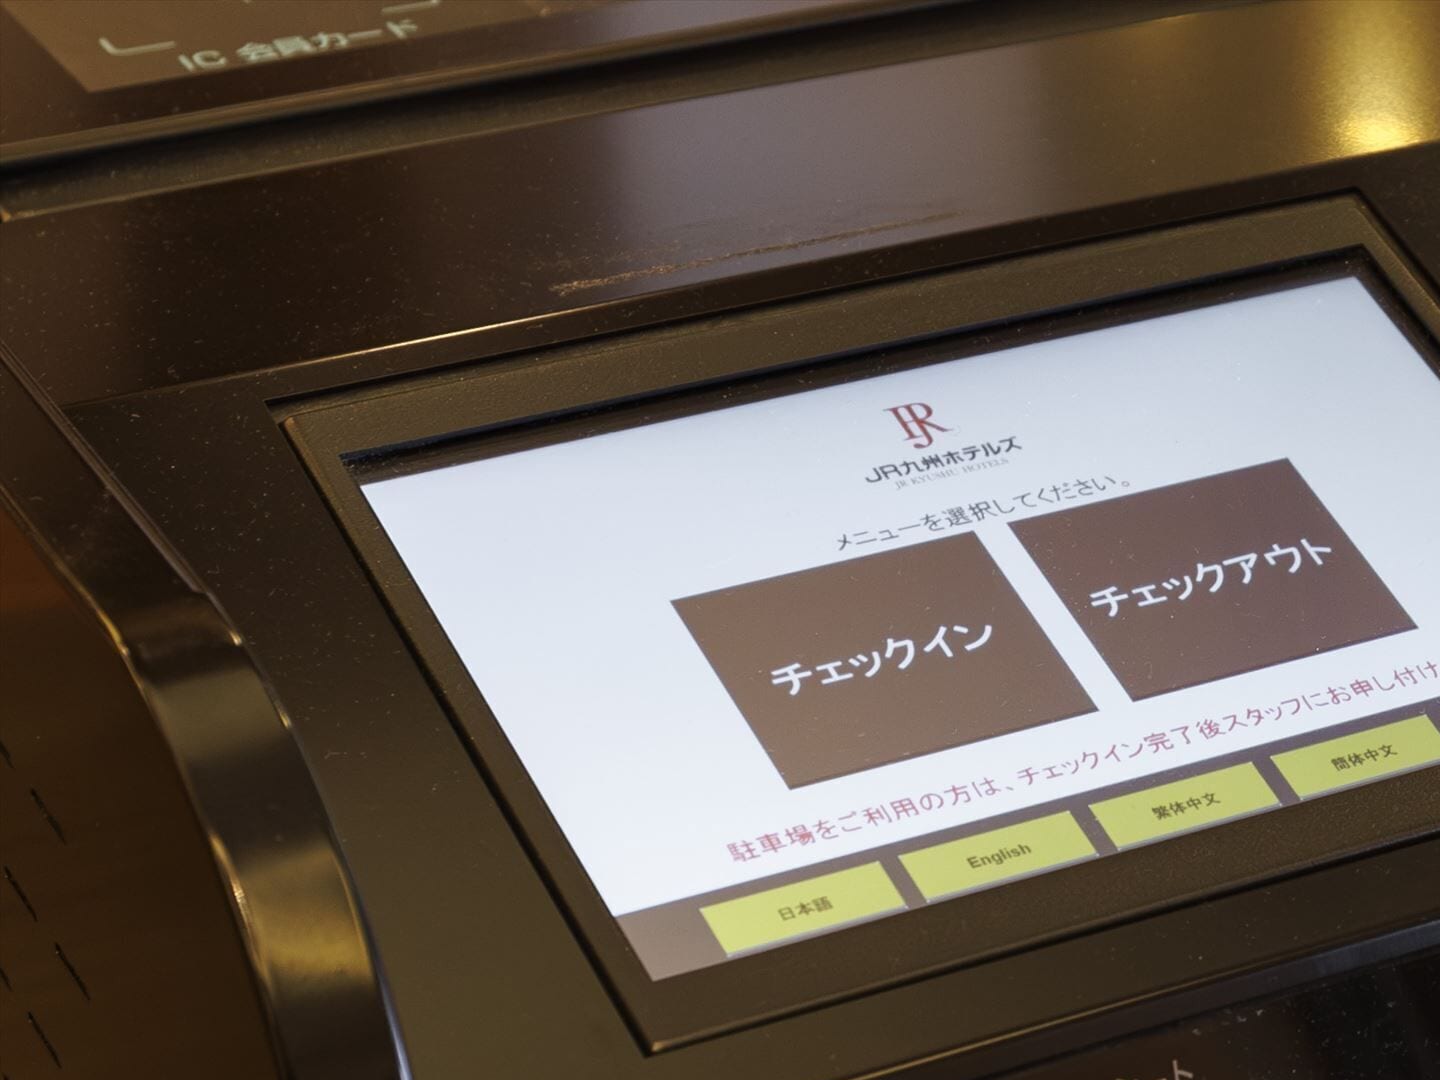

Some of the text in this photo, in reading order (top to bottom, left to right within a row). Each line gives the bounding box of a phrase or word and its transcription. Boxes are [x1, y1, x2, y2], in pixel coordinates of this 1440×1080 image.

[178, 50, 227, 72] IC
[864, 436, 1023, 484] JR九州ホテルズ
[836, 475, 1131, 551] メニューを選択してください。
[1089, 537, 1333, 618] チェックアウト
[770, 621, 994, 697] チェックイン
[1150, 790, 1221, 820] 繁体中文
[967, 842, 1032, 870] English
[777, 895, 833, 922] 日本語
